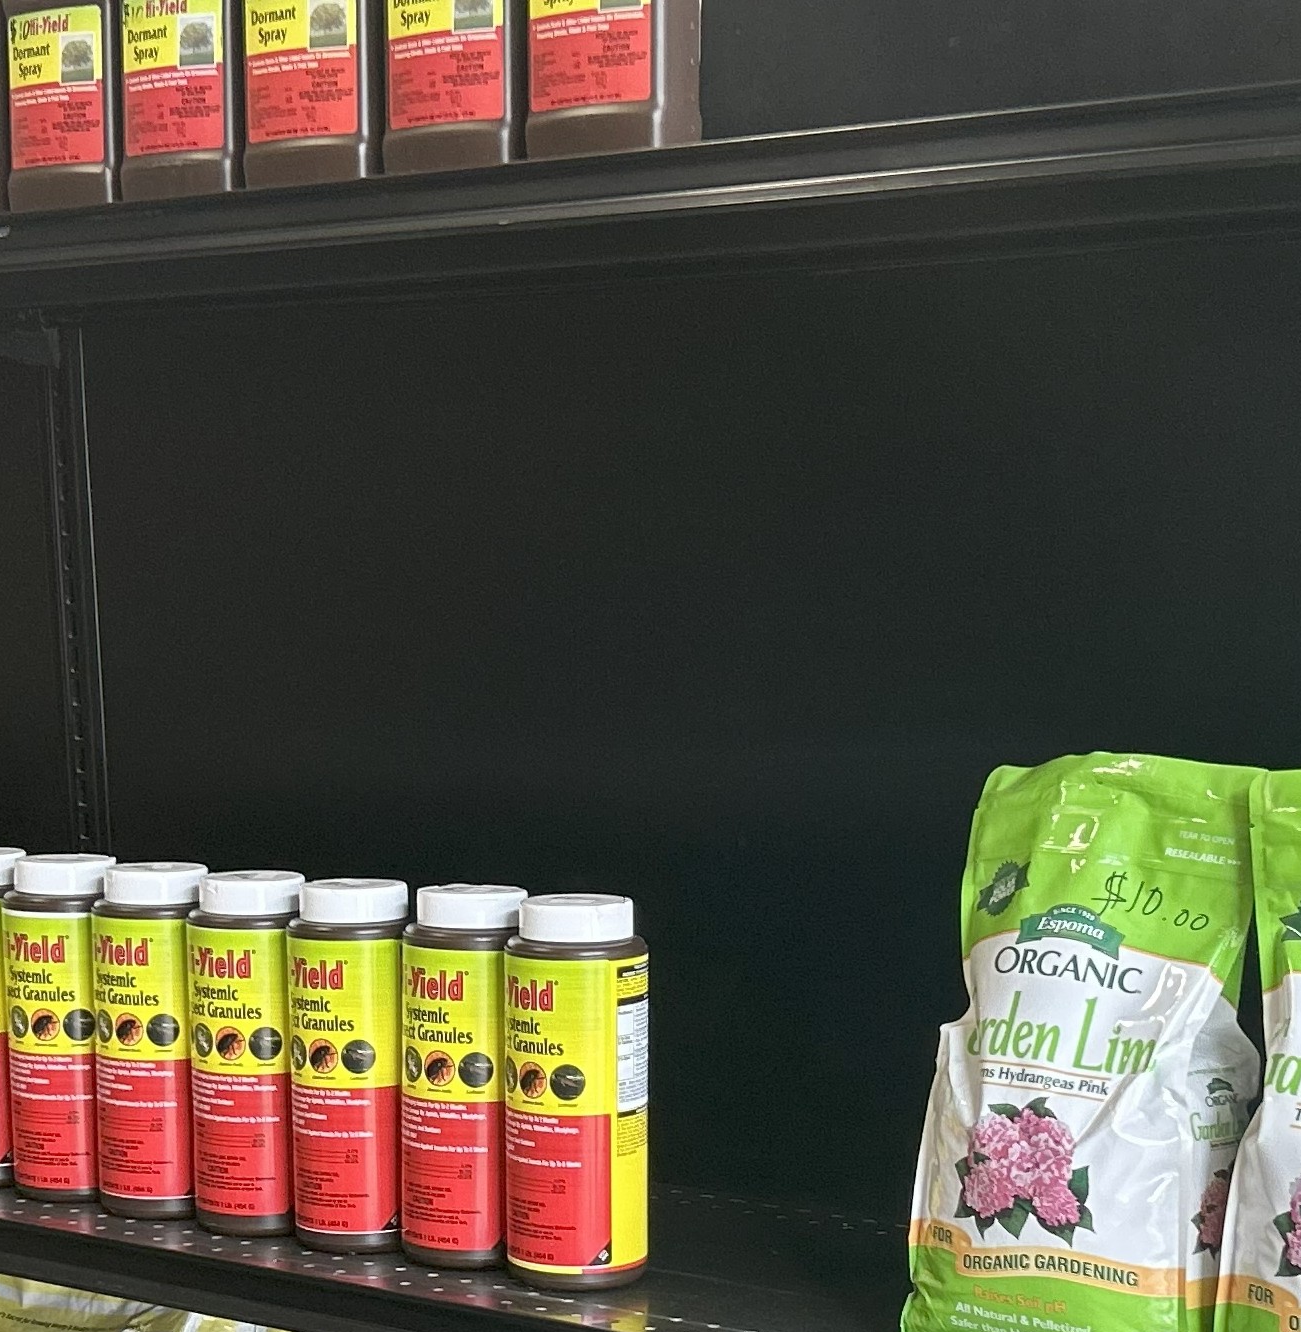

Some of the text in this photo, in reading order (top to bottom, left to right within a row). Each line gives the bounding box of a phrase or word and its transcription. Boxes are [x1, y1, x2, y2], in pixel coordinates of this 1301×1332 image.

[251, 4, 296, 26] Dormant
[400, 8, 432, 28] Spray
[127, 25, 167, 44] Dormant
[258, 26, 288, 46] Spray
[13, 43, 50, 62] Dormant
[133, 46, 160, 62] Spray
[18, 62, 43, 79] Spray
[1165, 846, 1226, 866] RESEALABLE
[1091, 871, 1209, 932] $10.00
[1037, 916, 1106, 942] Espoma
[6, 934, 66, 963] i-Yield
[190, 949, 252, 979] i-Yield
[994, 945, 1143, 995] ORGANIC
[291, 960, 344, 990] -Yield
[402, 964, 465, 1001] i-Yield
[23, 986, 76, 1003] Granules
[194, 985, 239, 1002] Systemic
[207, 1003, 262, 1020] Granules
[302, 1015, 355, 1032] Granules
[417, 1026, 473, 1045] Granules
[512, 1038, 564, 1057] Granules
[998, 1067, 1110, 1097] Hydrangeas Pink
[932, 1226, 953, 1245] FOR
[962, 1252, 1139, 1287] ORGANIC GARDENING
[1247, 1283, 1274, 1306] FOR
